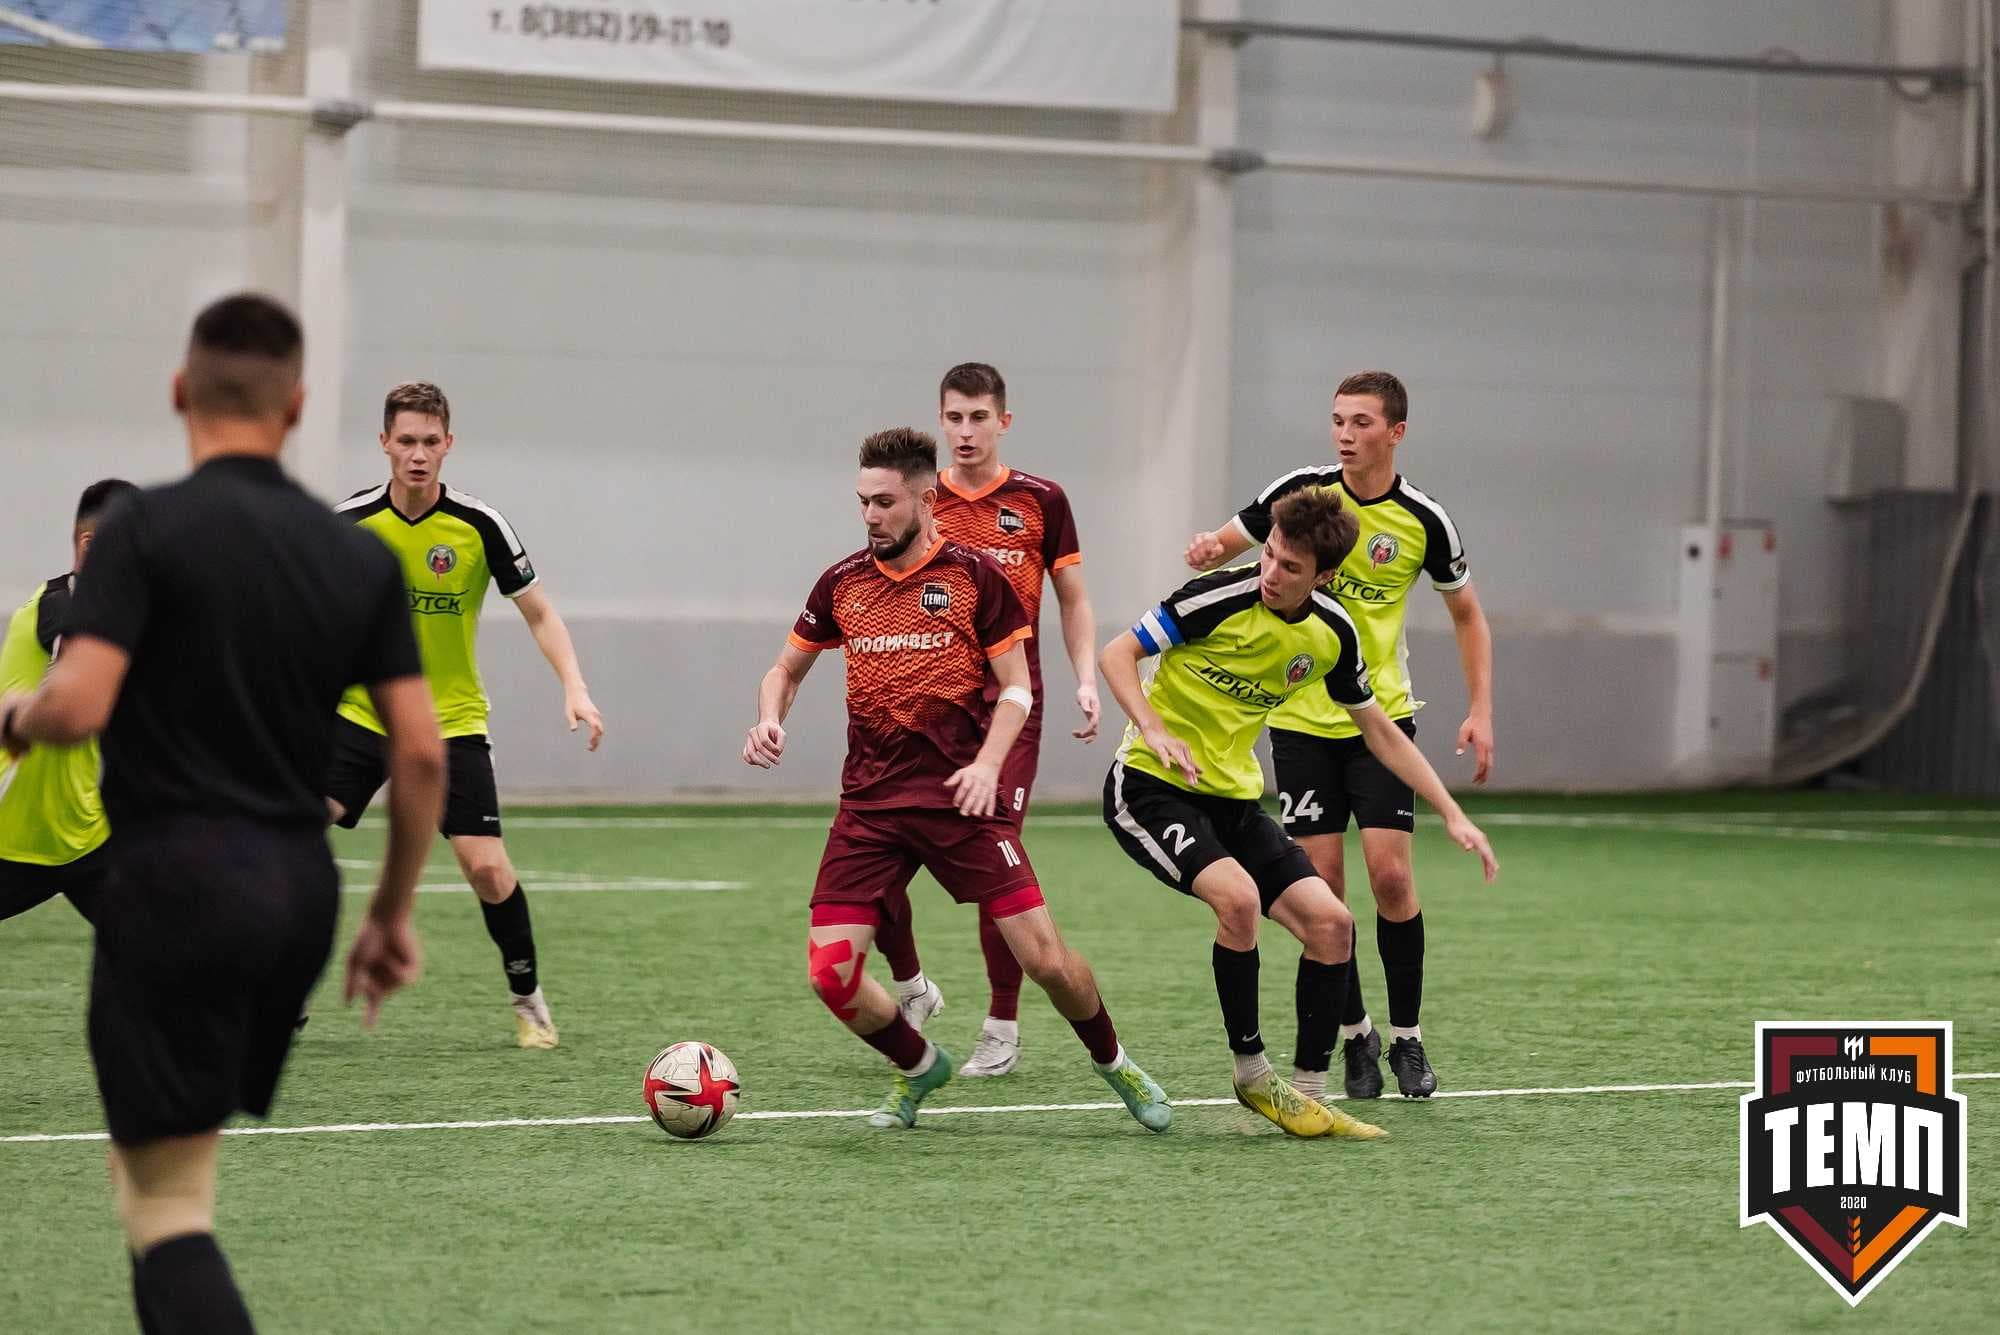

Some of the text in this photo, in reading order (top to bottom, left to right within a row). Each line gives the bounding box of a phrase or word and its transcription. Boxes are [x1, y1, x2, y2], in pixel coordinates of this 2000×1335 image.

[923, 593, 948, 607] ТЕМП
[1013, 787, 1025, 812] 9
[1279, 789, 1324, 824] 24
[1162, 822, 1196, 856] 2
[997, 840, 1021, 868] 10
